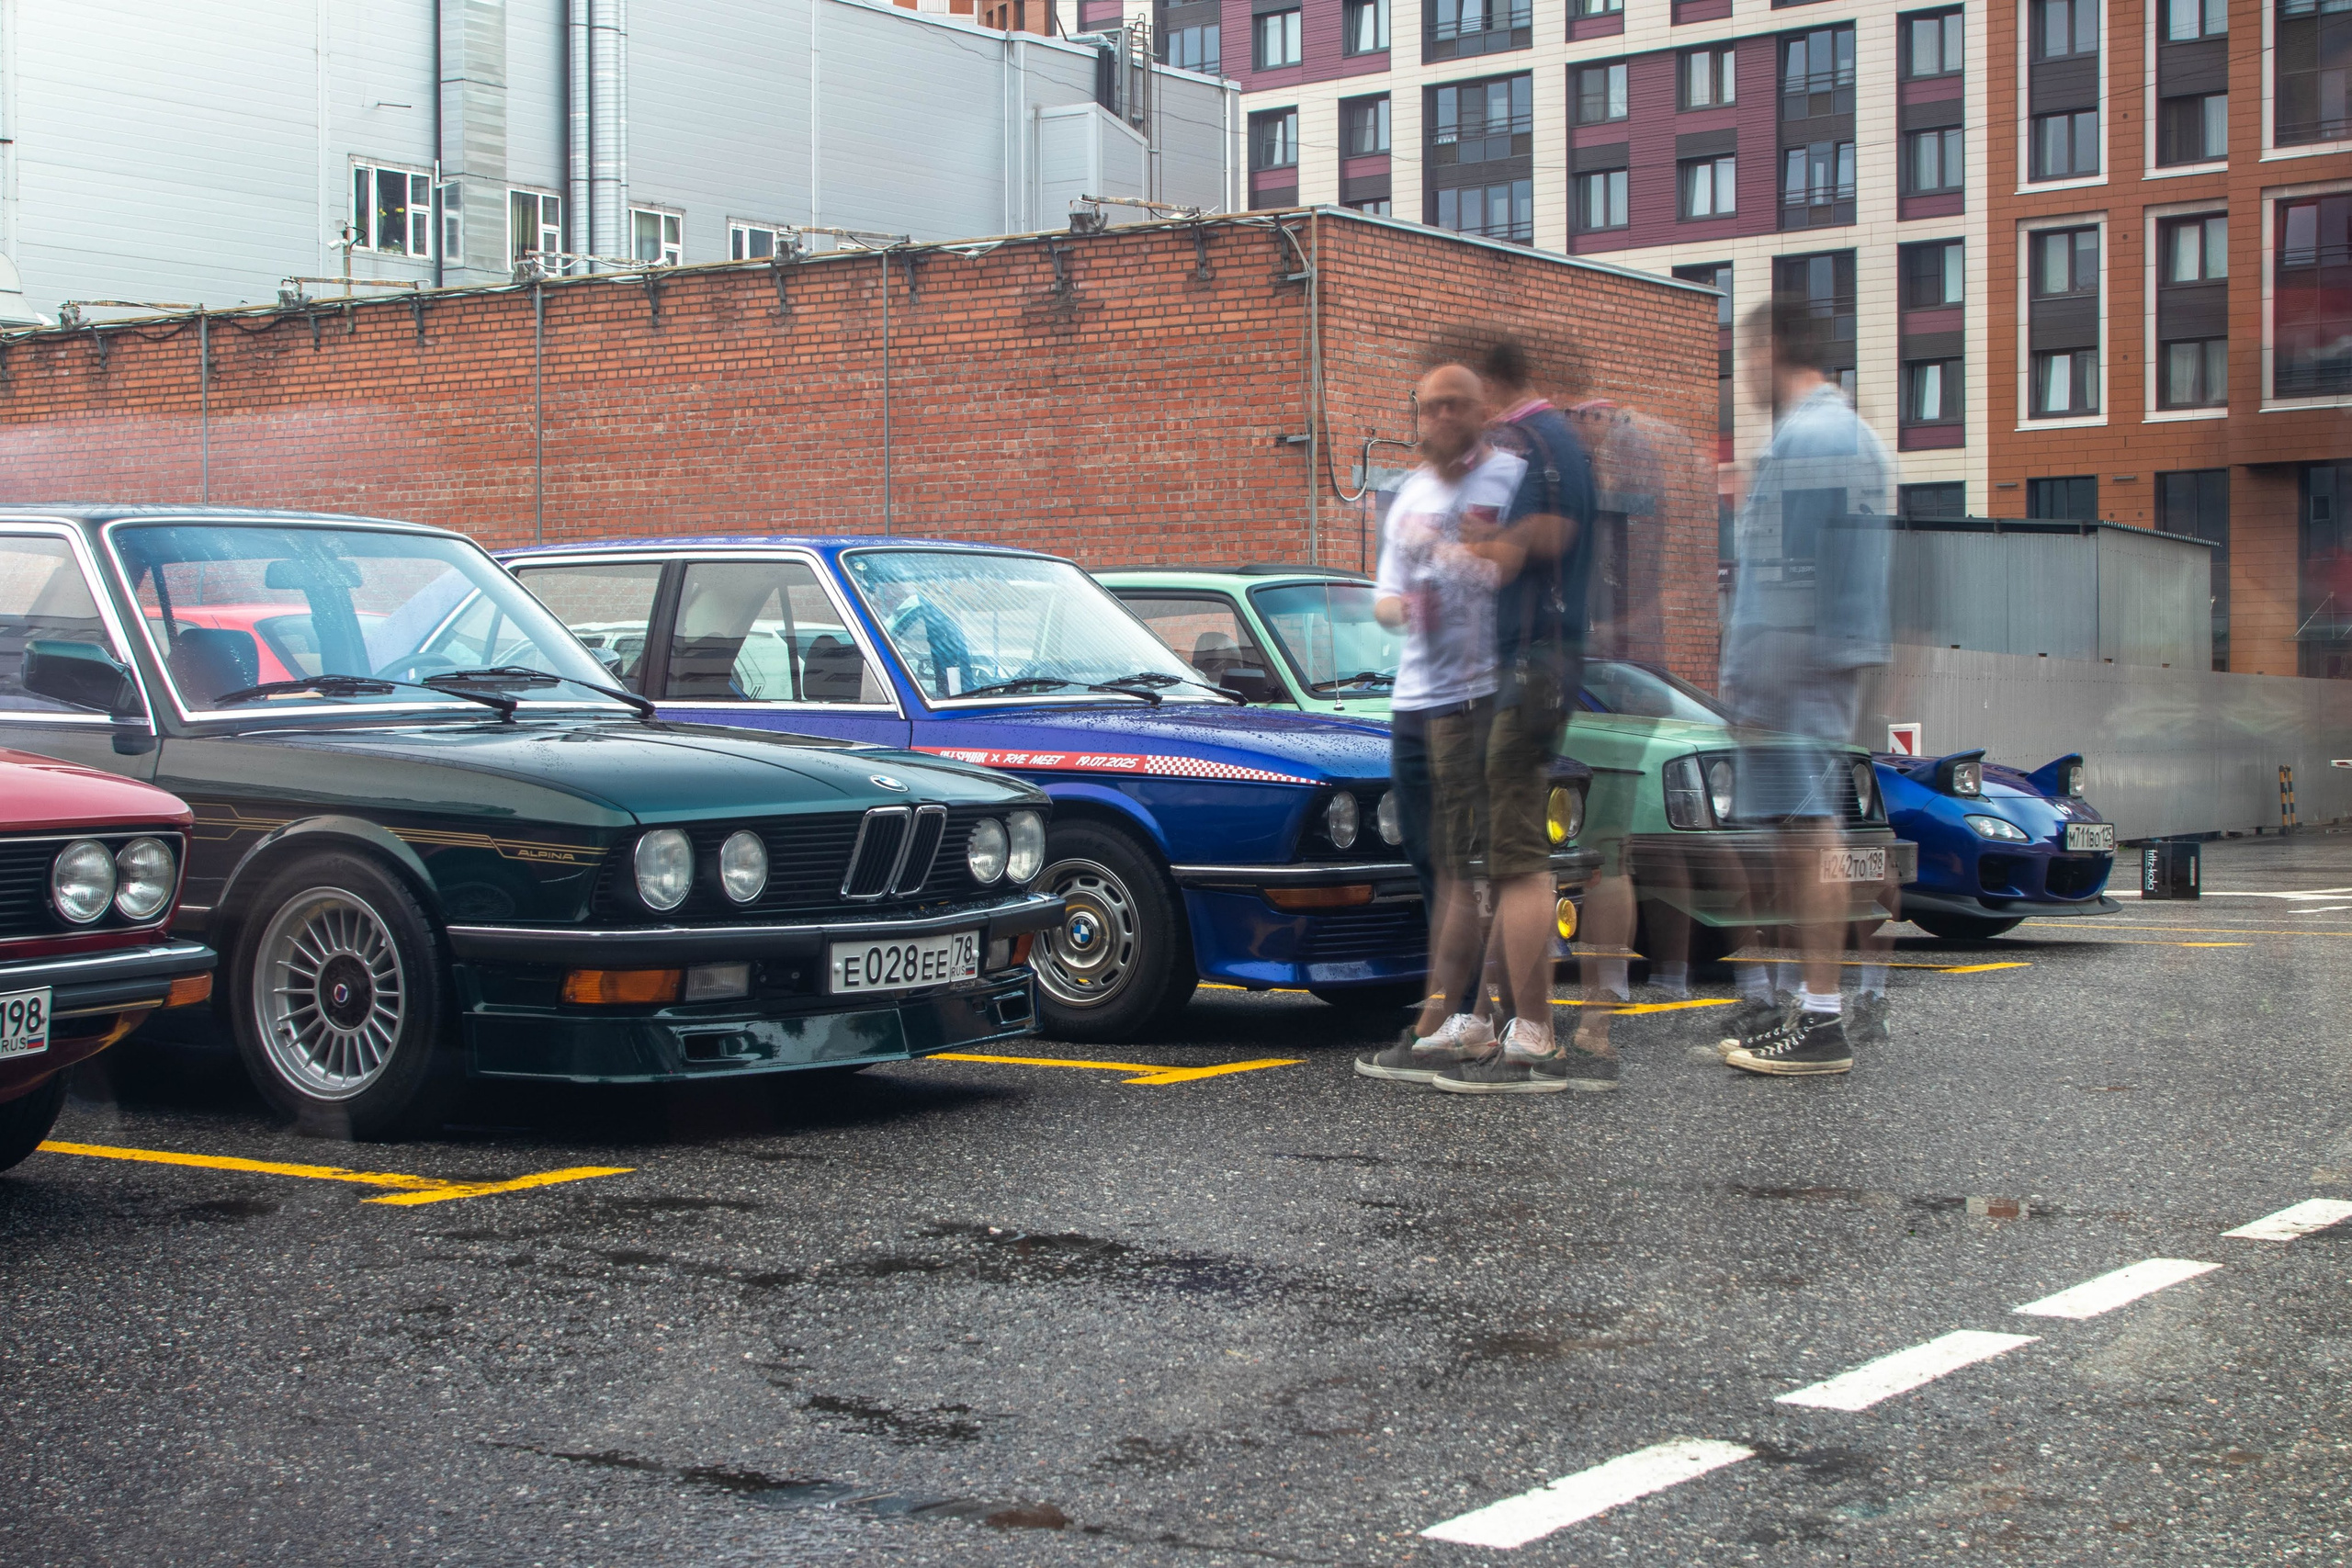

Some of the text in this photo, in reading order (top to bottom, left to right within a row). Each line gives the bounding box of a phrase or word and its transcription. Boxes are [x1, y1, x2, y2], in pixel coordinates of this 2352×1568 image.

[1002, 753, 1029, 764] RYE
[1028, 755, 1066, 765] MEET
[1075, 755, 1139, 769] 19.07.2025
[517, 850, 575, 861] ALPINA
[1868, 852, 1883, 871] 198
[2147, 850, 2158, 890] fritz-kola
[955, 935, 973, 965] 78
[951, 965, 966, 976] RUS
[0, 997, 42, 1039] 198
[2, 1037, 27, 1053] RUS
